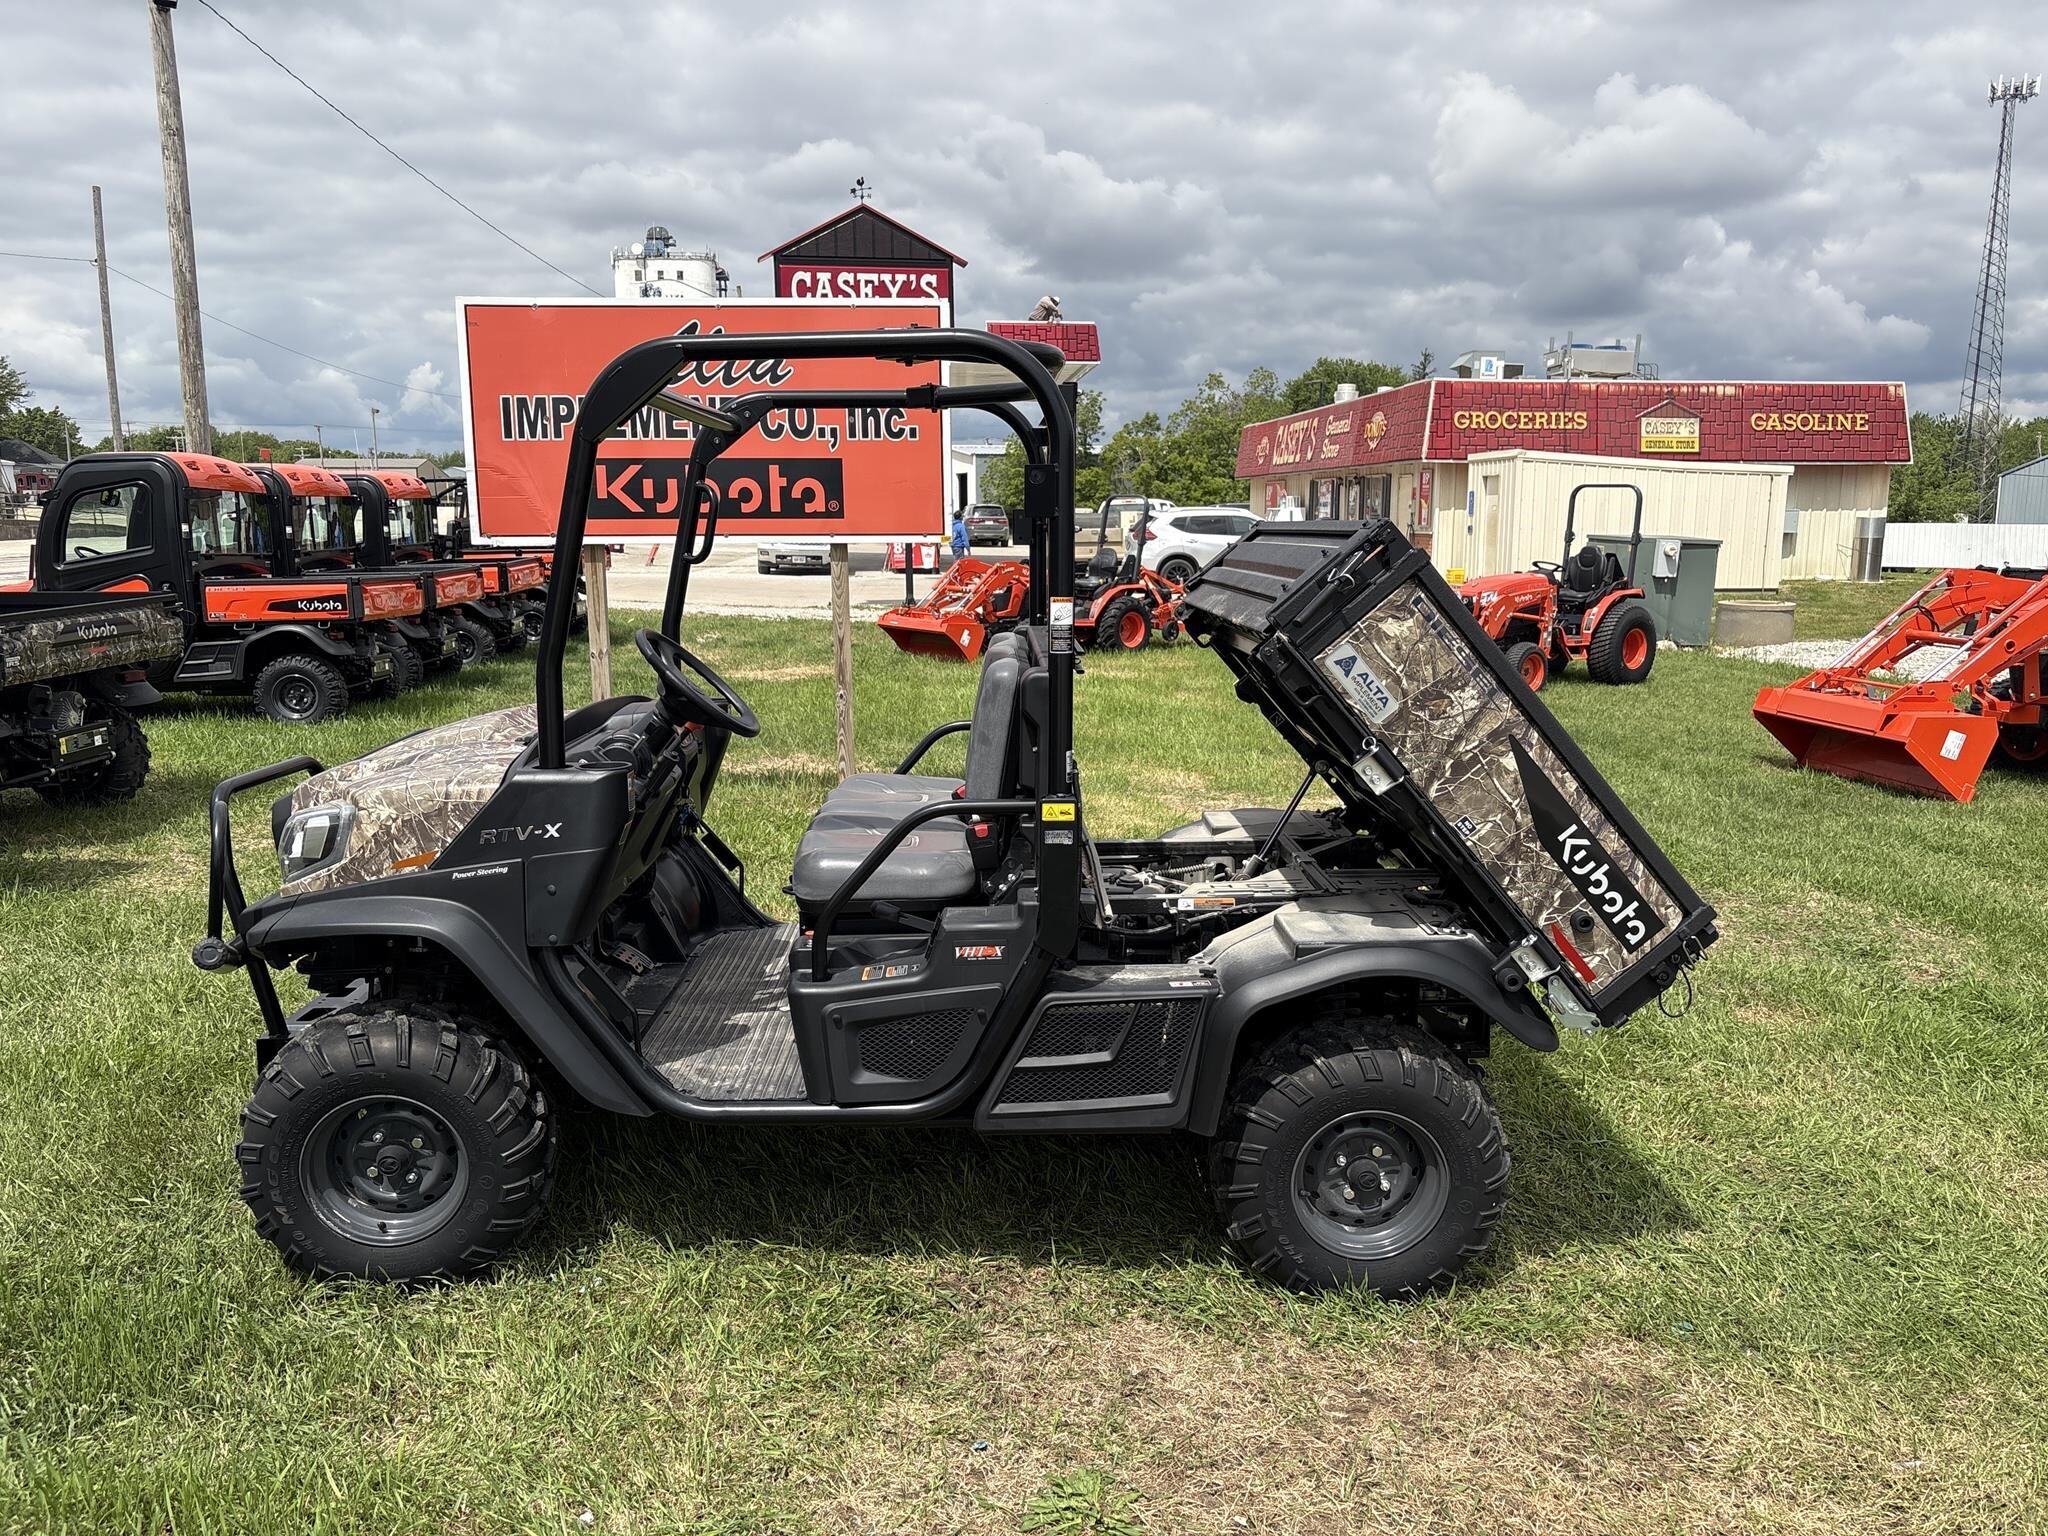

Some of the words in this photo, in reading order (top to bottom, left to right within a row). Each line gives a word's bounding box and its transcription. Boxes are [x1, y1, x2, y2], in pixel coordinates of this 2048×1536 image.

[791, 271, 939, 300] CASEY'S
[1453, 410, 1588, 431] GROCERIES
[1645, 421, 1696, 435] CASEY'S
[1750, 413, 1870, 432] GASOLINE
[1273, 417, 1319, 465] CASEY'S
[1645, 440, 1674, 449] GENERAL
[1675, 440, 1696, 449] STORE
[298, 600, 343, 611] Kubota
[77, 622, 118, 640] Kubota
[1351, 675, 1383, 713] IMPLEMENT
[1356, 672, 1389, 709] ALTA
[480, 822, 562, 845] RTV-X
[1457, 821, 1470, 834] STEP
[1464, 820, 1473, 830] NO
[452, 871, 477, 880] Power
[476, 866, 509, 877] Steering
[1557, 823, 1646, 946] Kubota
